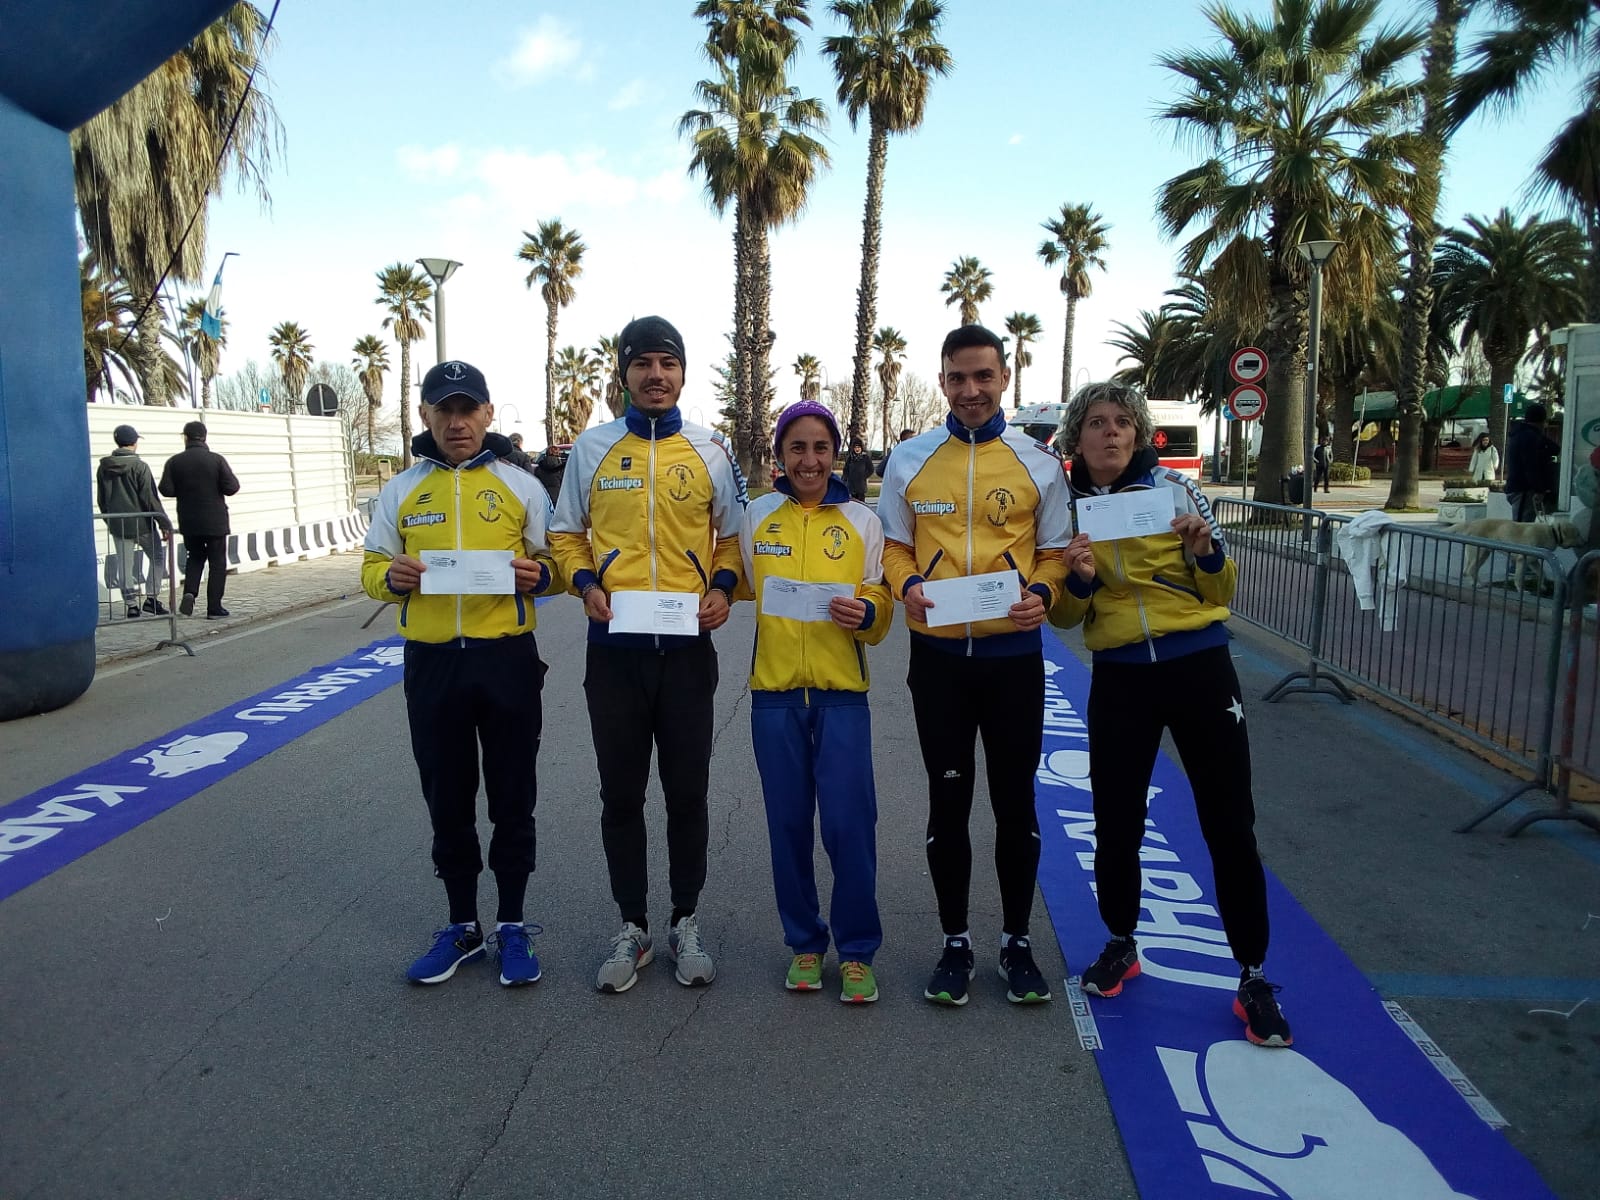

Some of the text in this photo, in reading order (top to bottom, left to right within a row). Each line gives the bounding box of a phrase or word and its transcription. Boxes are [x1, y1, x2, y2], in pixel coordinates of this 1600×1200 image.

[599, 476, 643, 491] Technipes
[912, 500, 956, 516] Technipes
[404, 511, 445, 527] Technipes
[755, 541, 790, 557] Technipes
[234, 667, 384, 721] KARHU
[0, 783, 149, 864] KAR
